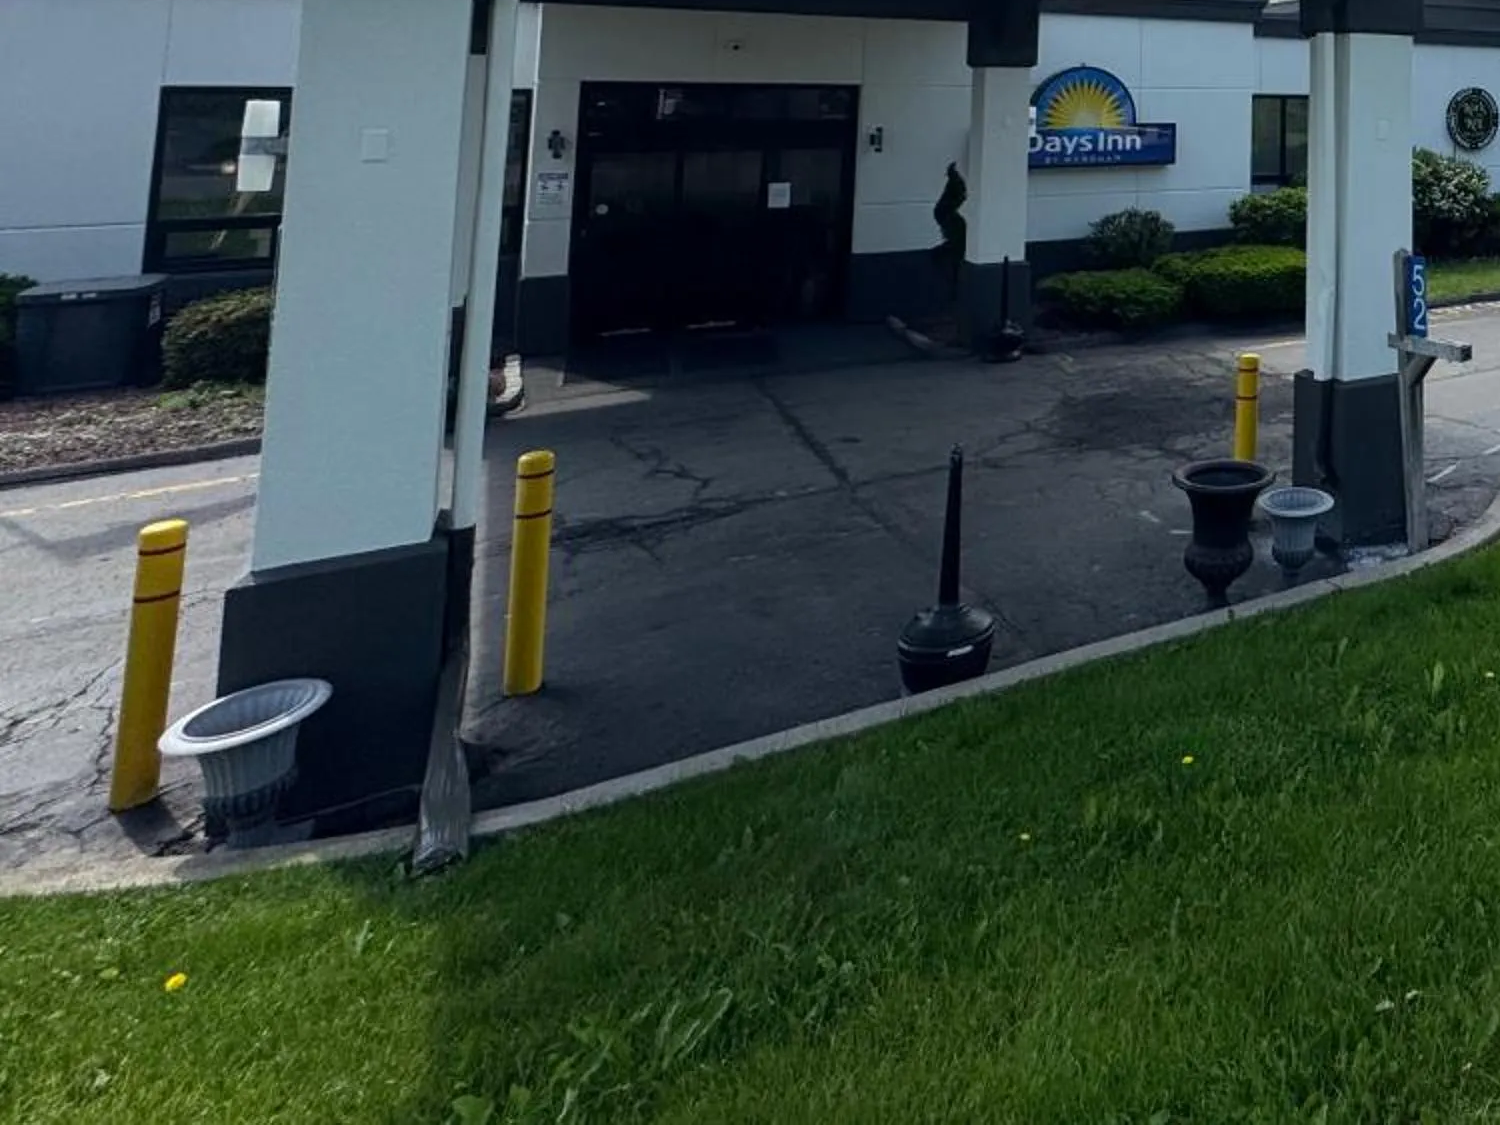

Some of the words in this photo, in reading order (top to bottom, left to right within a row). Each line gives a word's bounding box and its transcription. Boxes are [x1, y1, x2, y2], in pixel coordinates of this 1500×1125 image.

[1028, 134, 1093, 155] Days
[1098, 131, 1142, 152] Inn
[1412, 264, 1426, 330] 52
